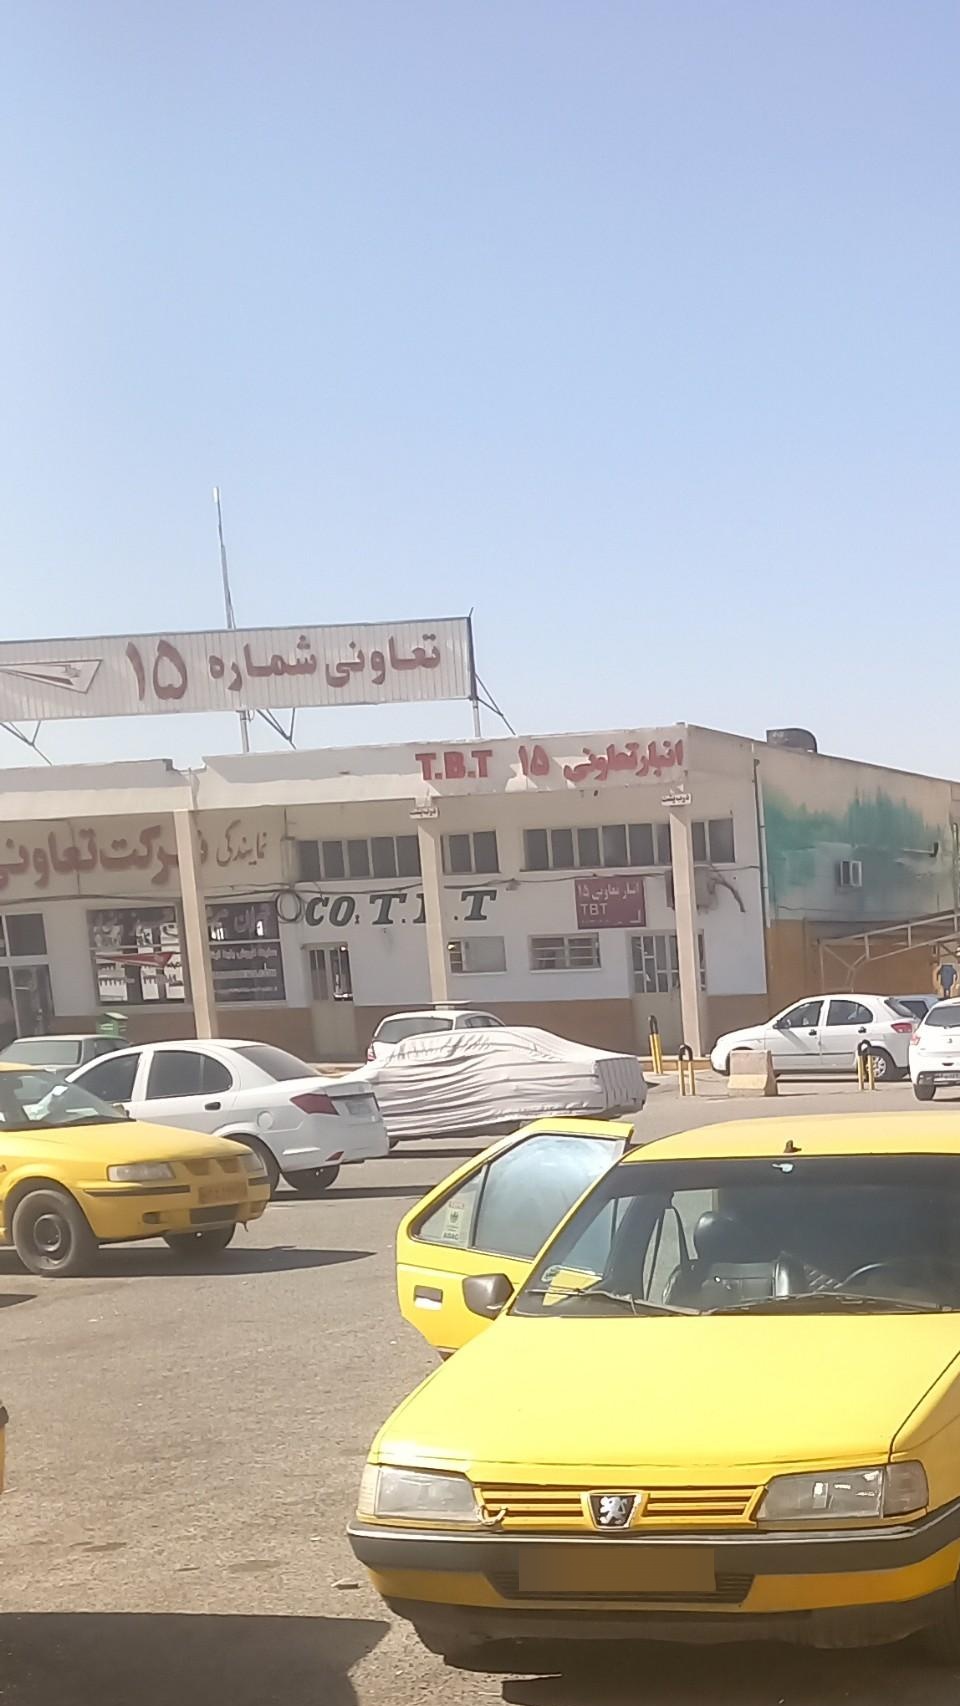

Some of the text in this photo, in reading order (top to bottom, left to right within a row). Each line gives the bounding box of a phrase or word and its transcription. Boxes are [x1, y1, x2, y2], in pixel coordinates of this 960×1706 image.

[125, 632, 441, 701] تعاونی شماره ۱۵
[414, 749, 494, 781] T.B.T
[517, 739, 684, 782] انبار تعاونی ۱۵
[215, 819, 267, 868] نمایندگی
[580, 902, 608, 917] TBT
